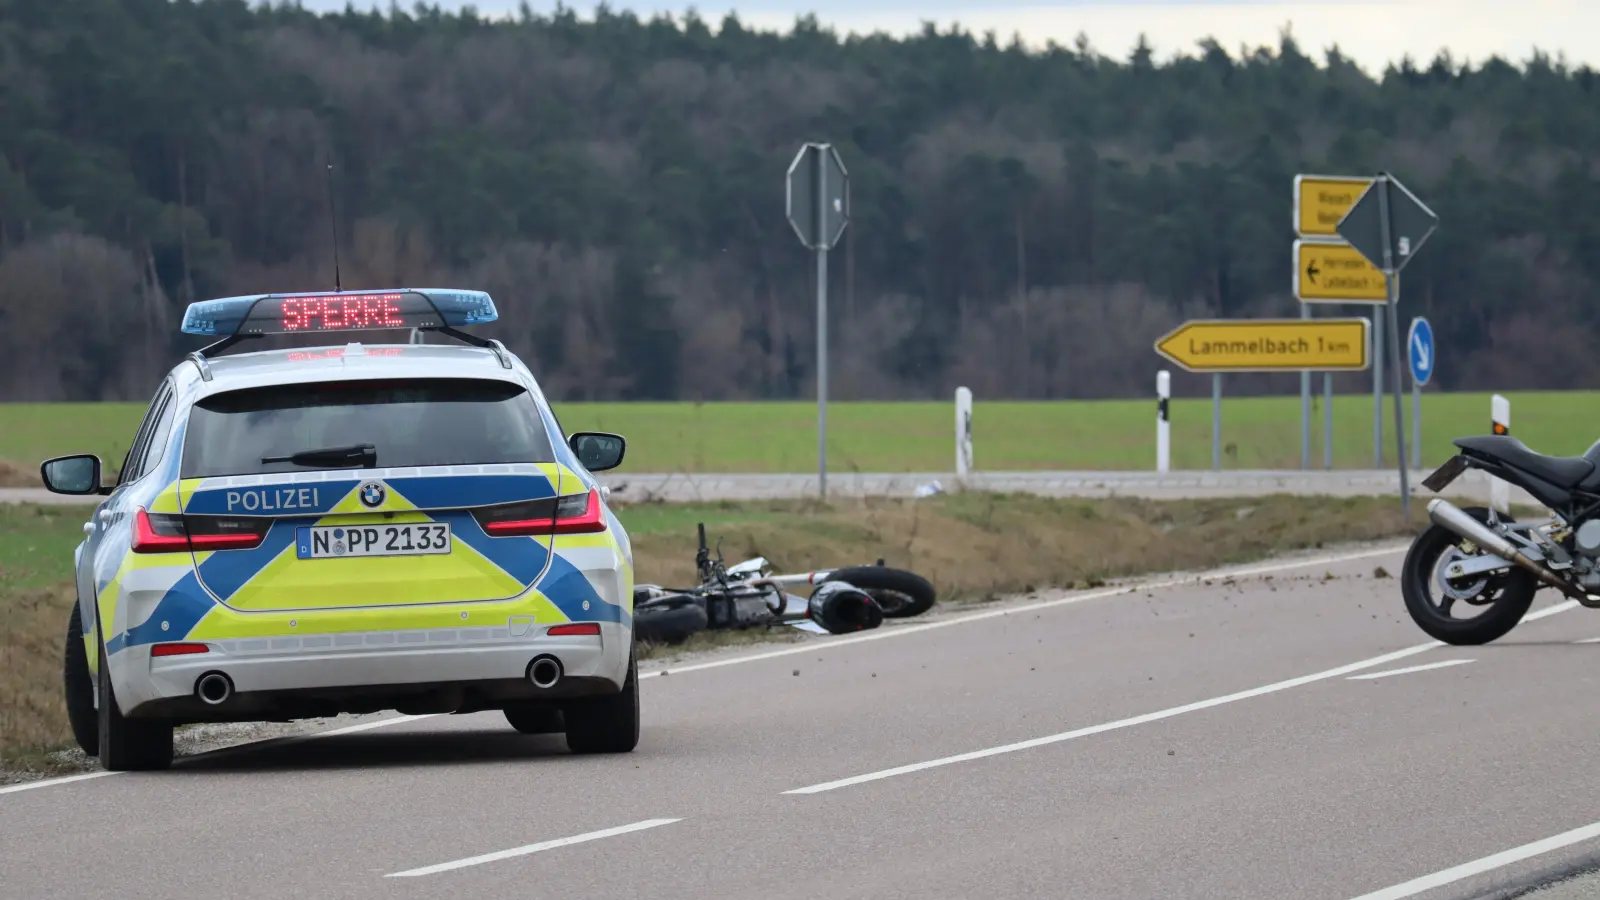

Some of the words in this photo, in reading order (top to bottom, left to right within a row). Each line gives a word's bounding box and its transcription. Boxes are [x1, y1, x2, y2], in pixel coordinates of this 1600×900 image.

[282, 293, 403, 328] SPERRE
[1189, 336, 1309, 355] Lammelbach
[226, 487, 319, 511] POLIZEI
[313, 530, 330, 554] N
[347, 528, 379, 552] PP
[385, 525, 447, 551] 2133
